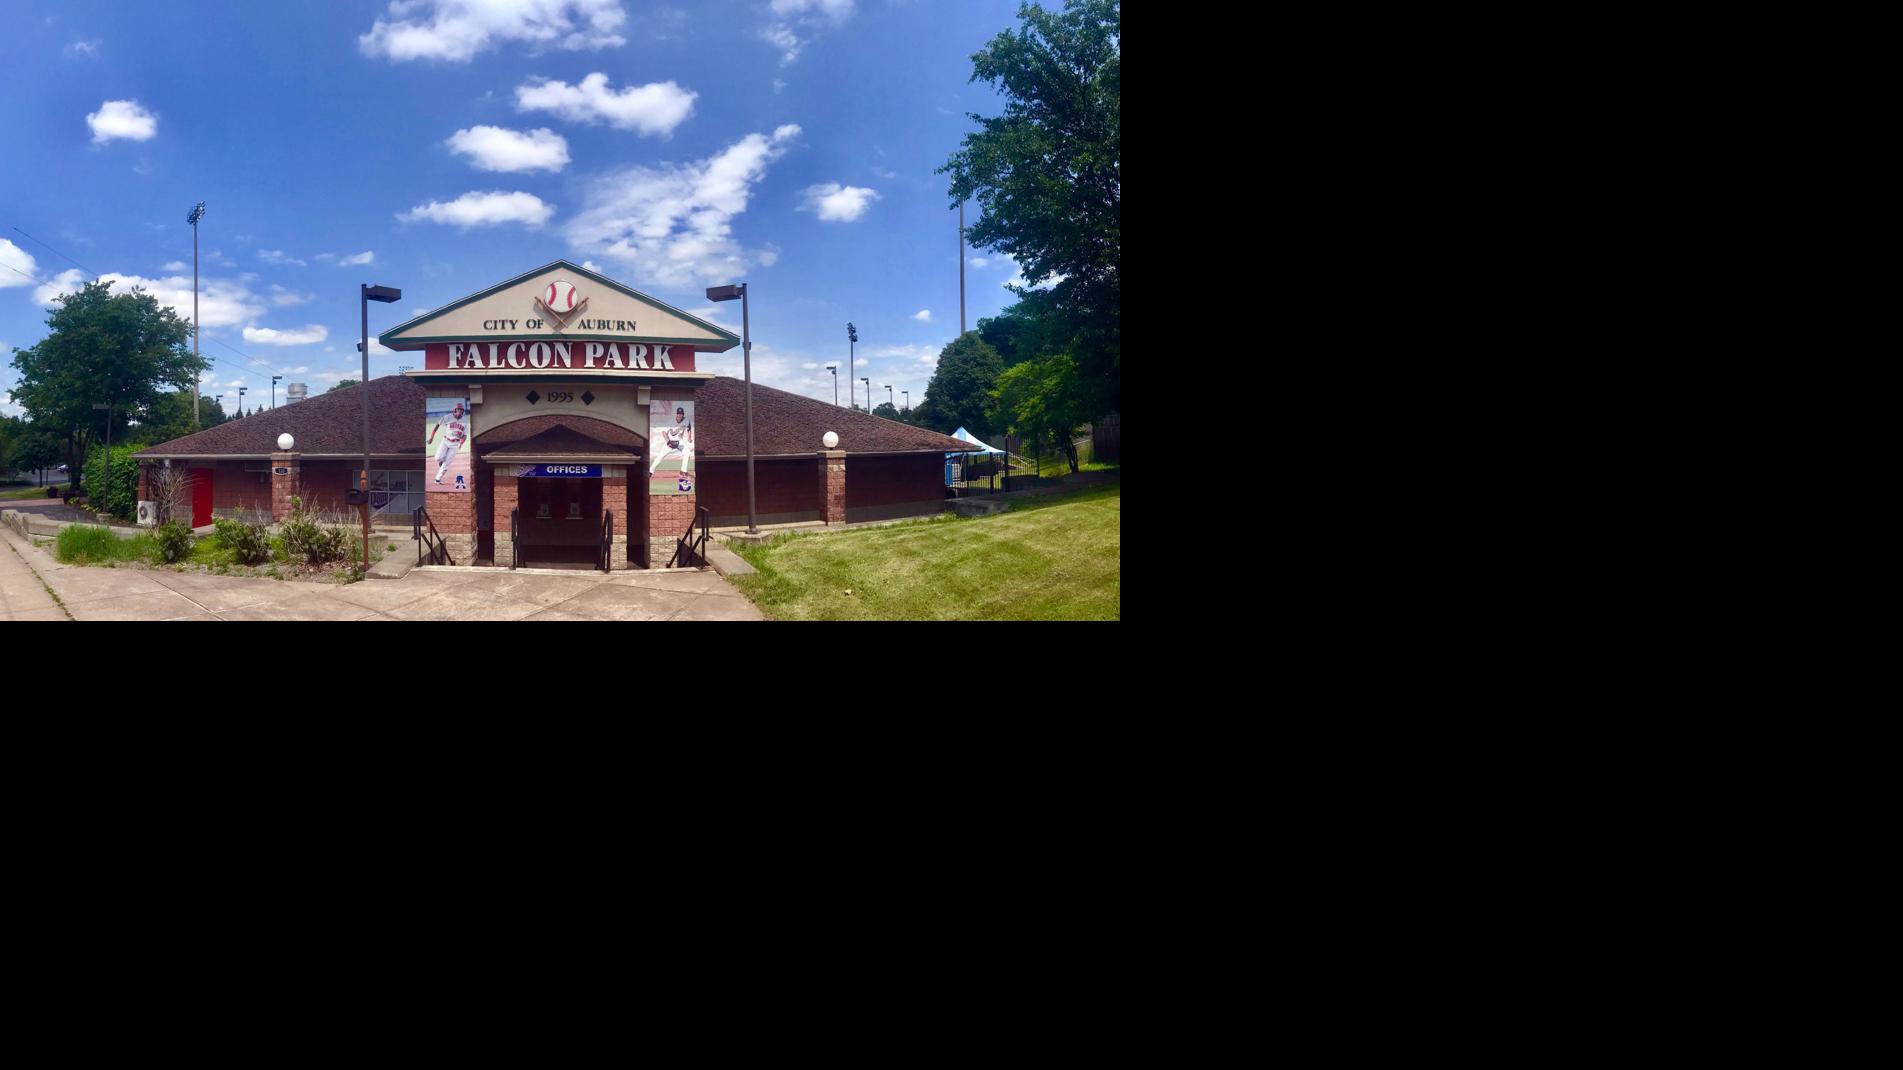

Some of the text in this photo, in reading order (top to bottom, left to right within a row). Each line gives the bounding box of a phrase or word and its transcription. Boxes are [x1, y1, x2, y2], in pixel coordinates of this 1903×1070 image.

[483, 318, 637, 331] CITY OF AUBURN
[447, 341, 675, 370] FALCON PARK
[547, 391, 574, 403] 1995
[546, 465, 588, 474] OFFICES
